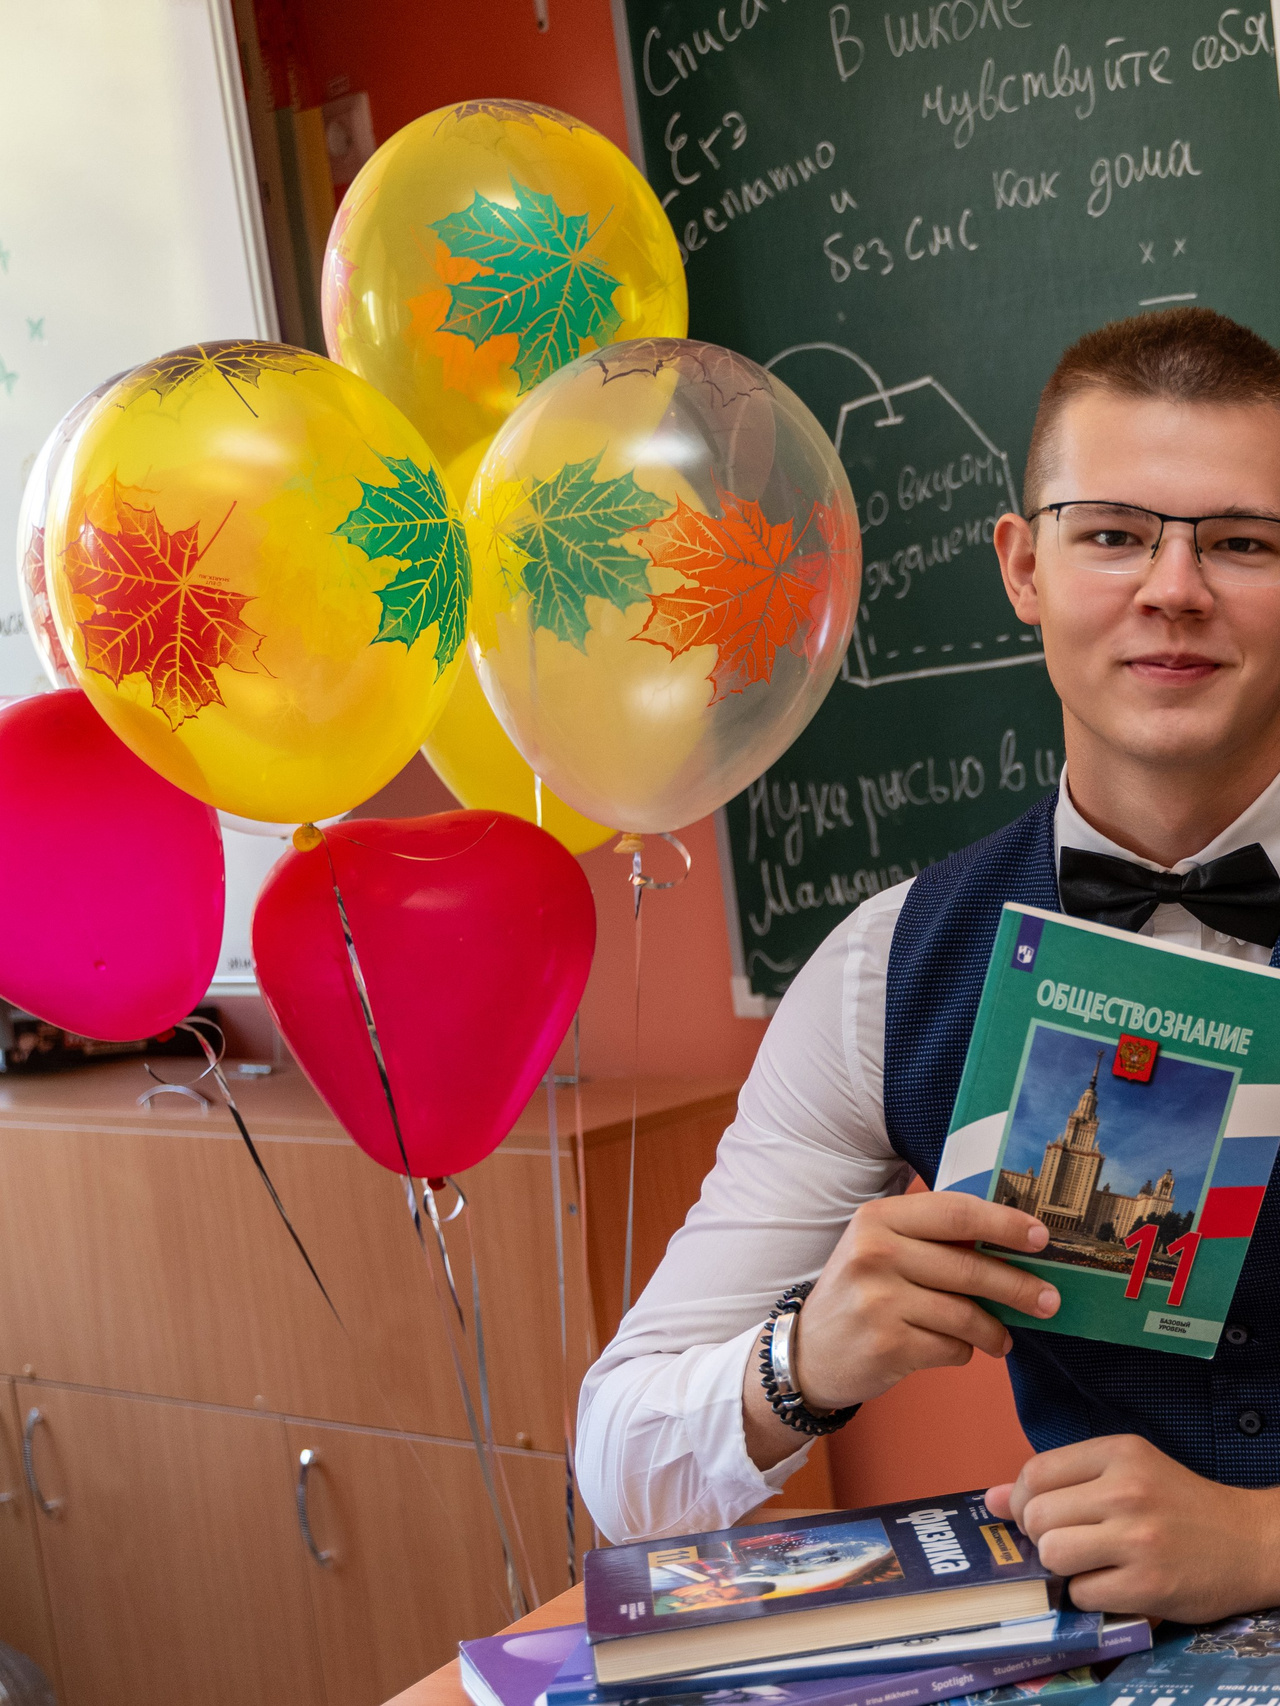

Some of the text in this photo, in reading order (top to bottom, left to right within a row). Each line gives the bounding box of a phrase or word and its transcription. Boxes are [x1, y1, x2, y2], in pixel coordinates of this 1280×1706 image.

[643, 0, 774, 96] Списа
[922, 38, 1173, 149] чувствуйте
[831, 188, 857, 214] и
[1087, 139, 1201, 217] дома
[823, 231, 894, 283] без
[865, 501, 1004, 601] экзамено
[1036, 979, 1254, 1056] ОБЩЕСТВОЗНАНИЕ
[1123, 1222, 1202, 1307] 11
[1158, 1324, 1187, 1334] УРОВЕНЬ
[1159, 1317, 1191, 1328] БАЗОВЫЙ
[656, 1550, 691, 1564] 11
[884, 1687, 919, 1701] Mikheeva
[931, 1673, 974, 1692] Spotlight
[993, 1660, 1031, 1676] Student's
[1032, 1654, 1052, 1670] Book
[1246, 1684, 1269, 1692] XXI
